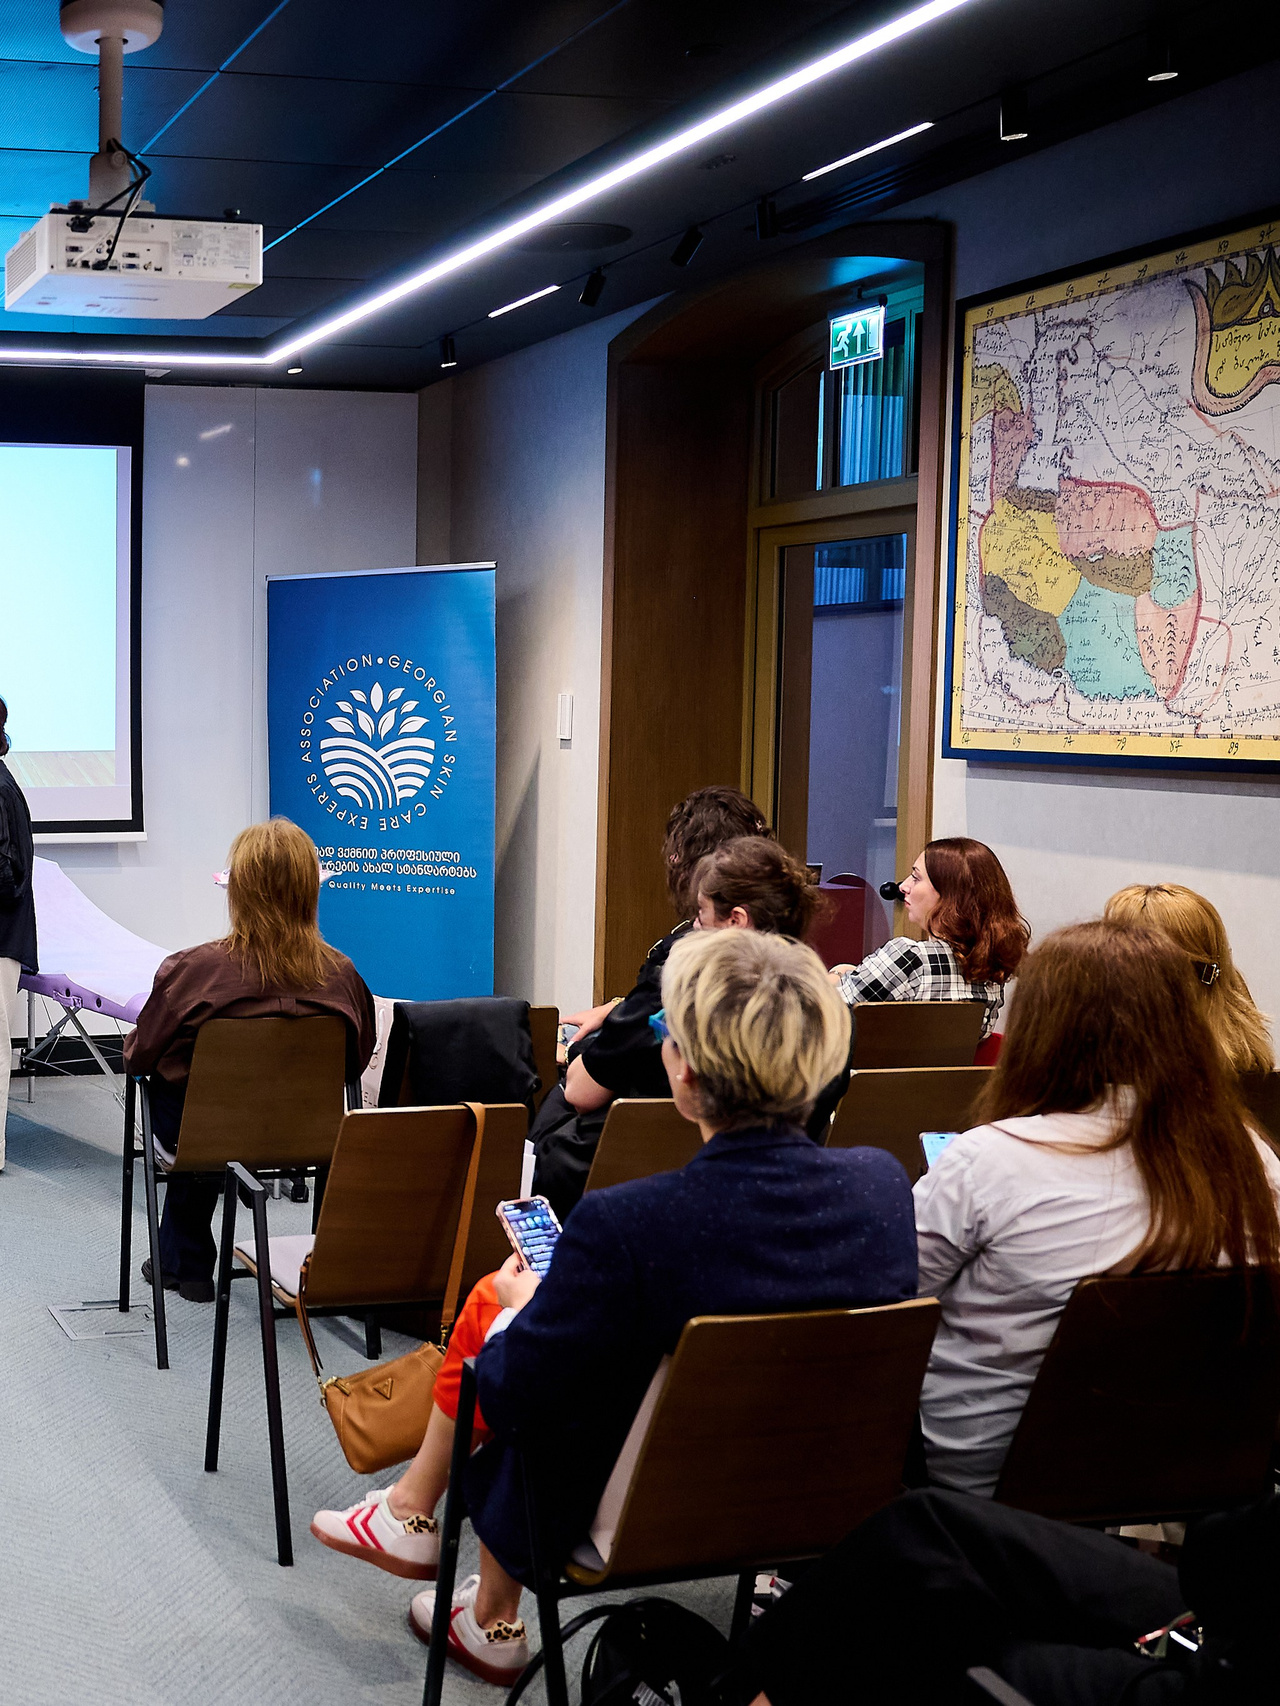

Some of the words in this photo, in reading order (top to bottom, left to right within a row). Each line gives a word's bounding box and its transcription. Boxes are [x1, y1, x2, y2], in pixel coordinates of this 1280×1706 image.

[300, 653, 372, 763] ASSOCIATION
[388, 654, 457, 742] GEORGIAN
[1117, 737, 1126, 750] 79
[1228, 742, 1239, 755] 89
[430, 754, 456, 799] SKIN
[306, 774, 368, 830] EXPERTS
[379, 803, 427, 831] CARE
[338, 848, 378, 860] ვქმნით
[381, 848, 460, 863] პროფესიული
[362, 862, 393, 874] ახალ
[396, 863, 477, 878] სტანდარტებს
[328, 881, 366, 891] Quality
[371, 883, 402, 892] Meets
[406, 884, 455, 895] Expertise
